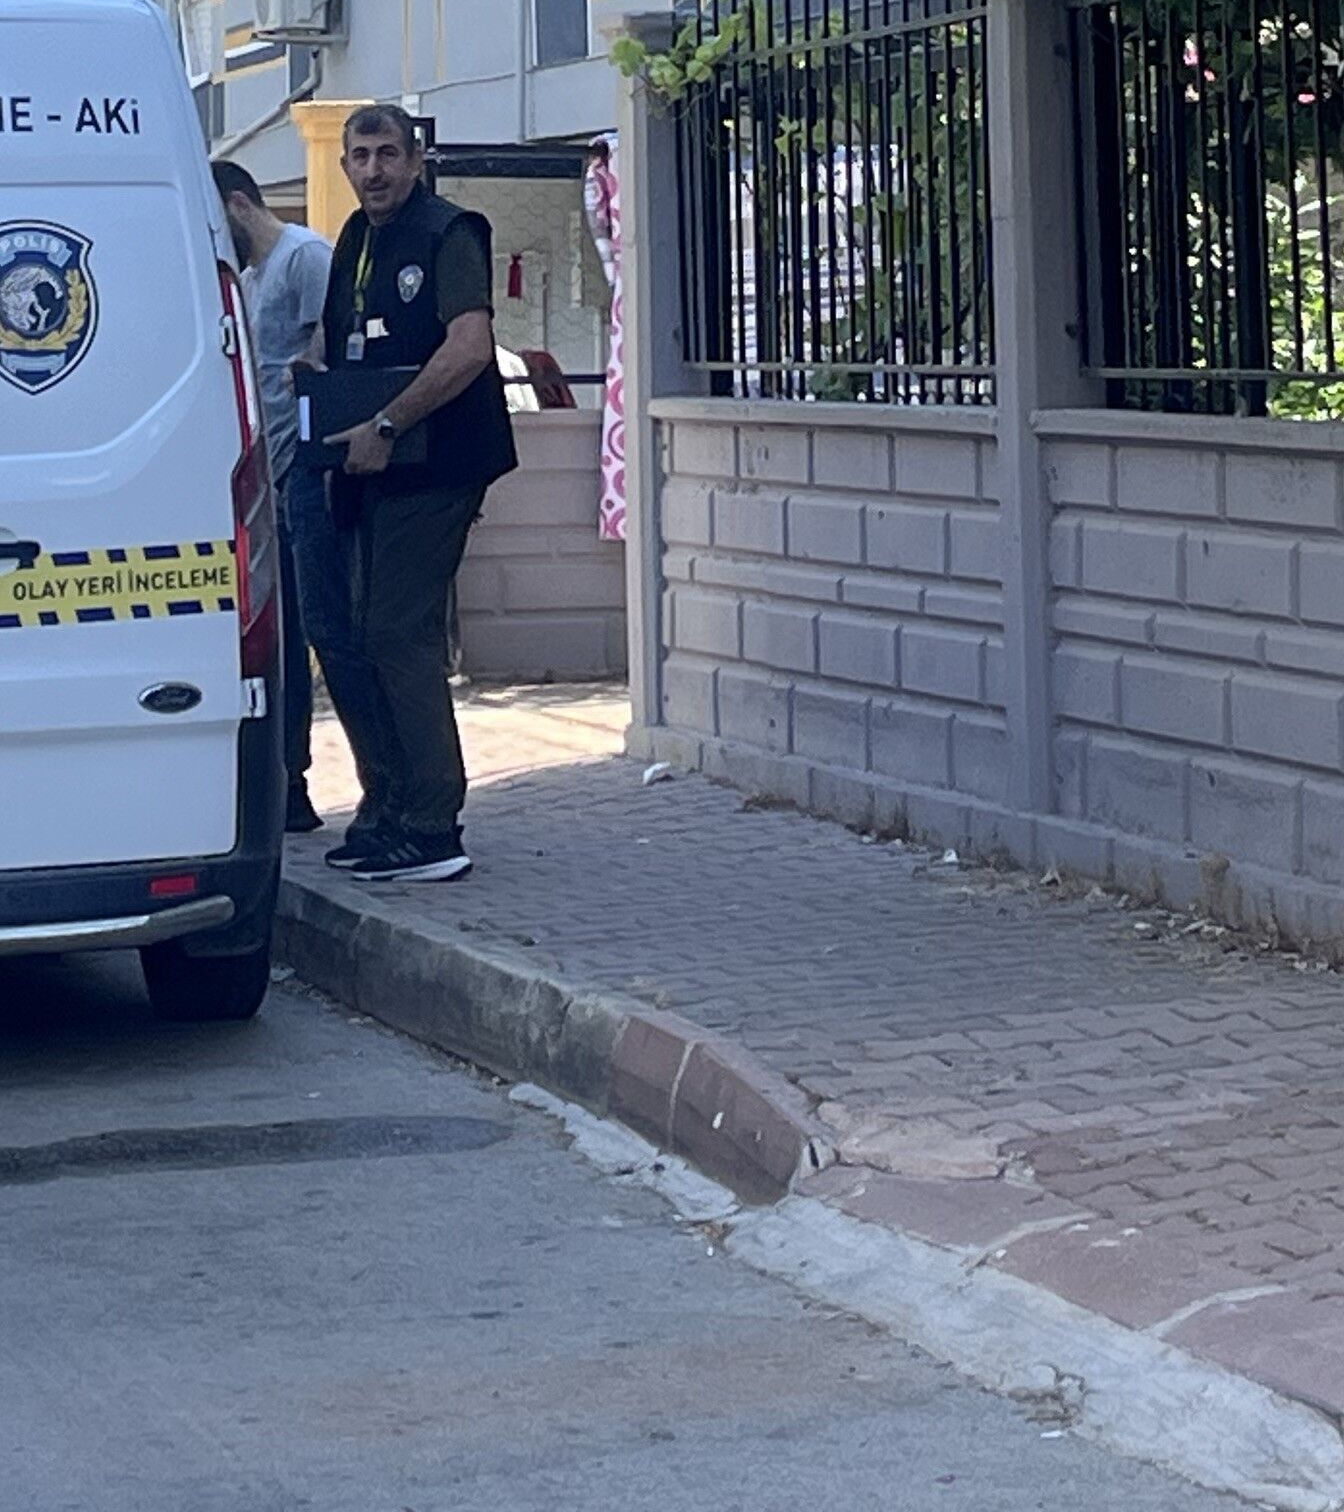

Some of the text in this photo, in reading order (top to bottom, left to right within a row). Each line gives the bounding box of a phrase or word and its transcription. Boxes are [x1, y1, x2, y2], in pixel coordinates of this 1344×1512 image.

[13, 577, 74, 601] OLAY
[74, 571, 122, 596] YERİ
[128, 566, 230, 593] İNCELEME
